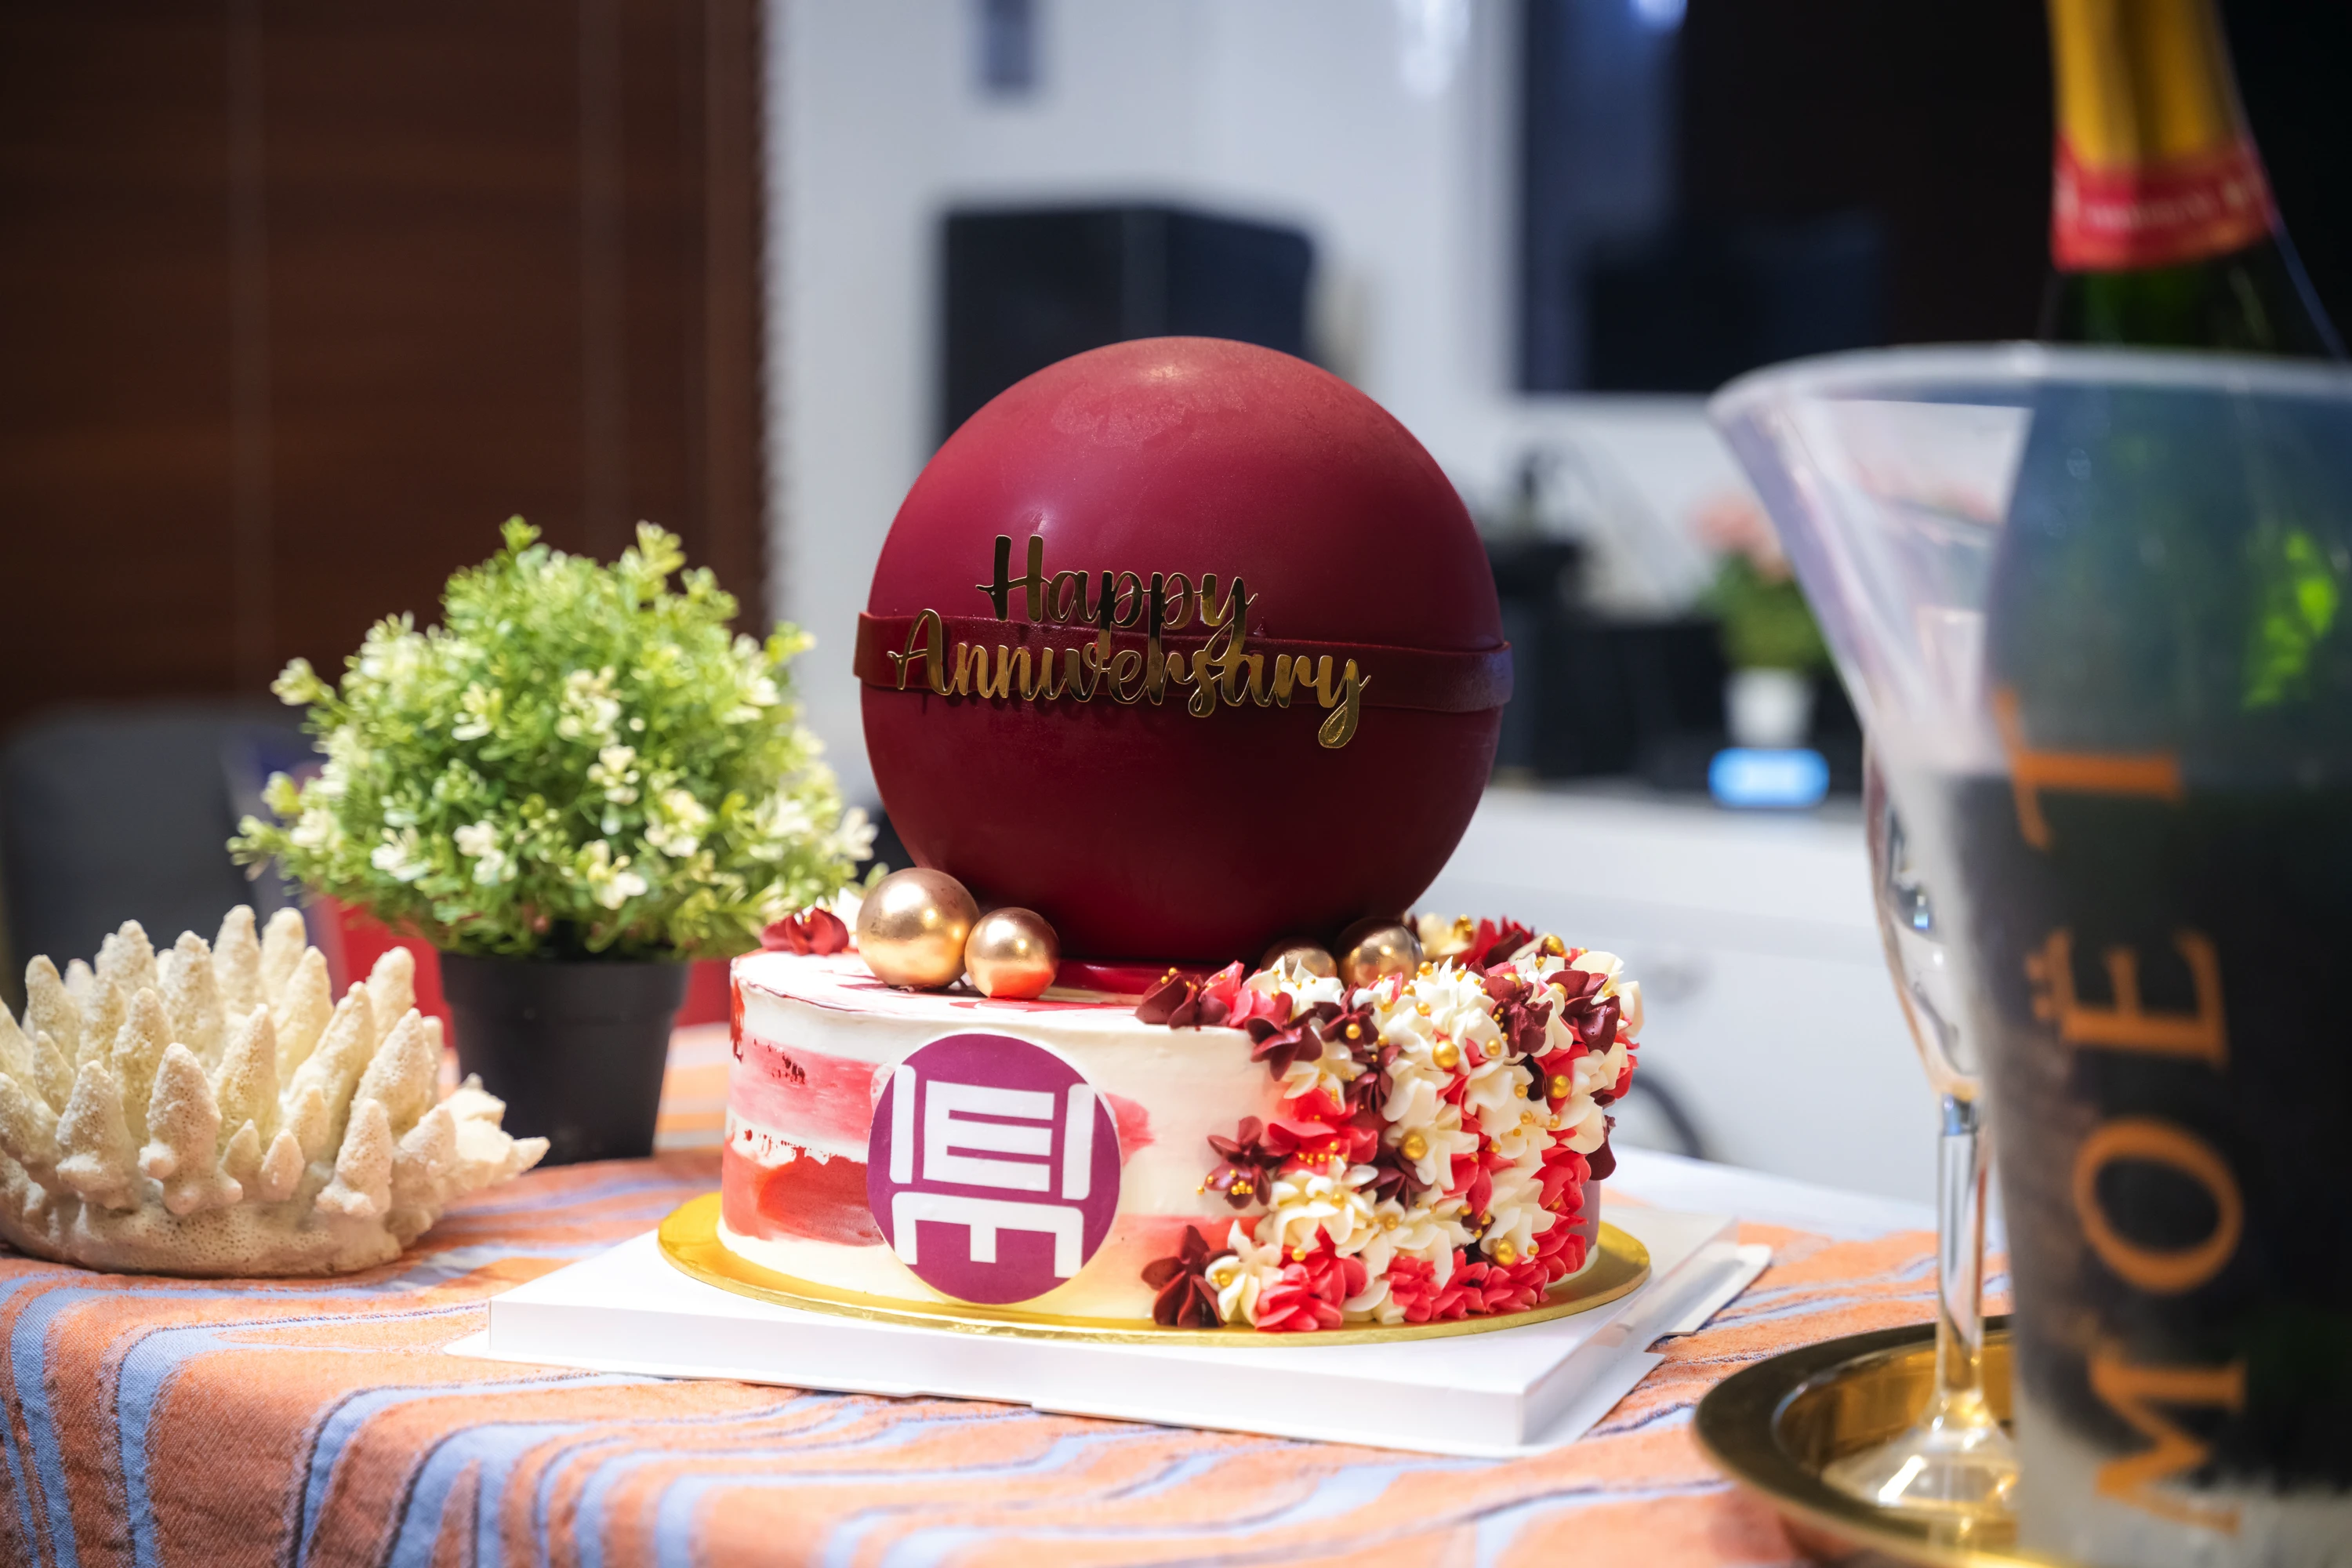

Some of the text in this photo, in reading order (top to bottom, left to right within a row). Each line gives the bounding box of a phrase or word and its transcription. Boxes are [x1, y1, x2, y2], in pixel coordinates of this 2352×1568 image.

[975, 535, 1258, 662] Happy
[887, 608, 1371, 748] Anniversary
[1993, 687, 2245, 1534] MOËT
